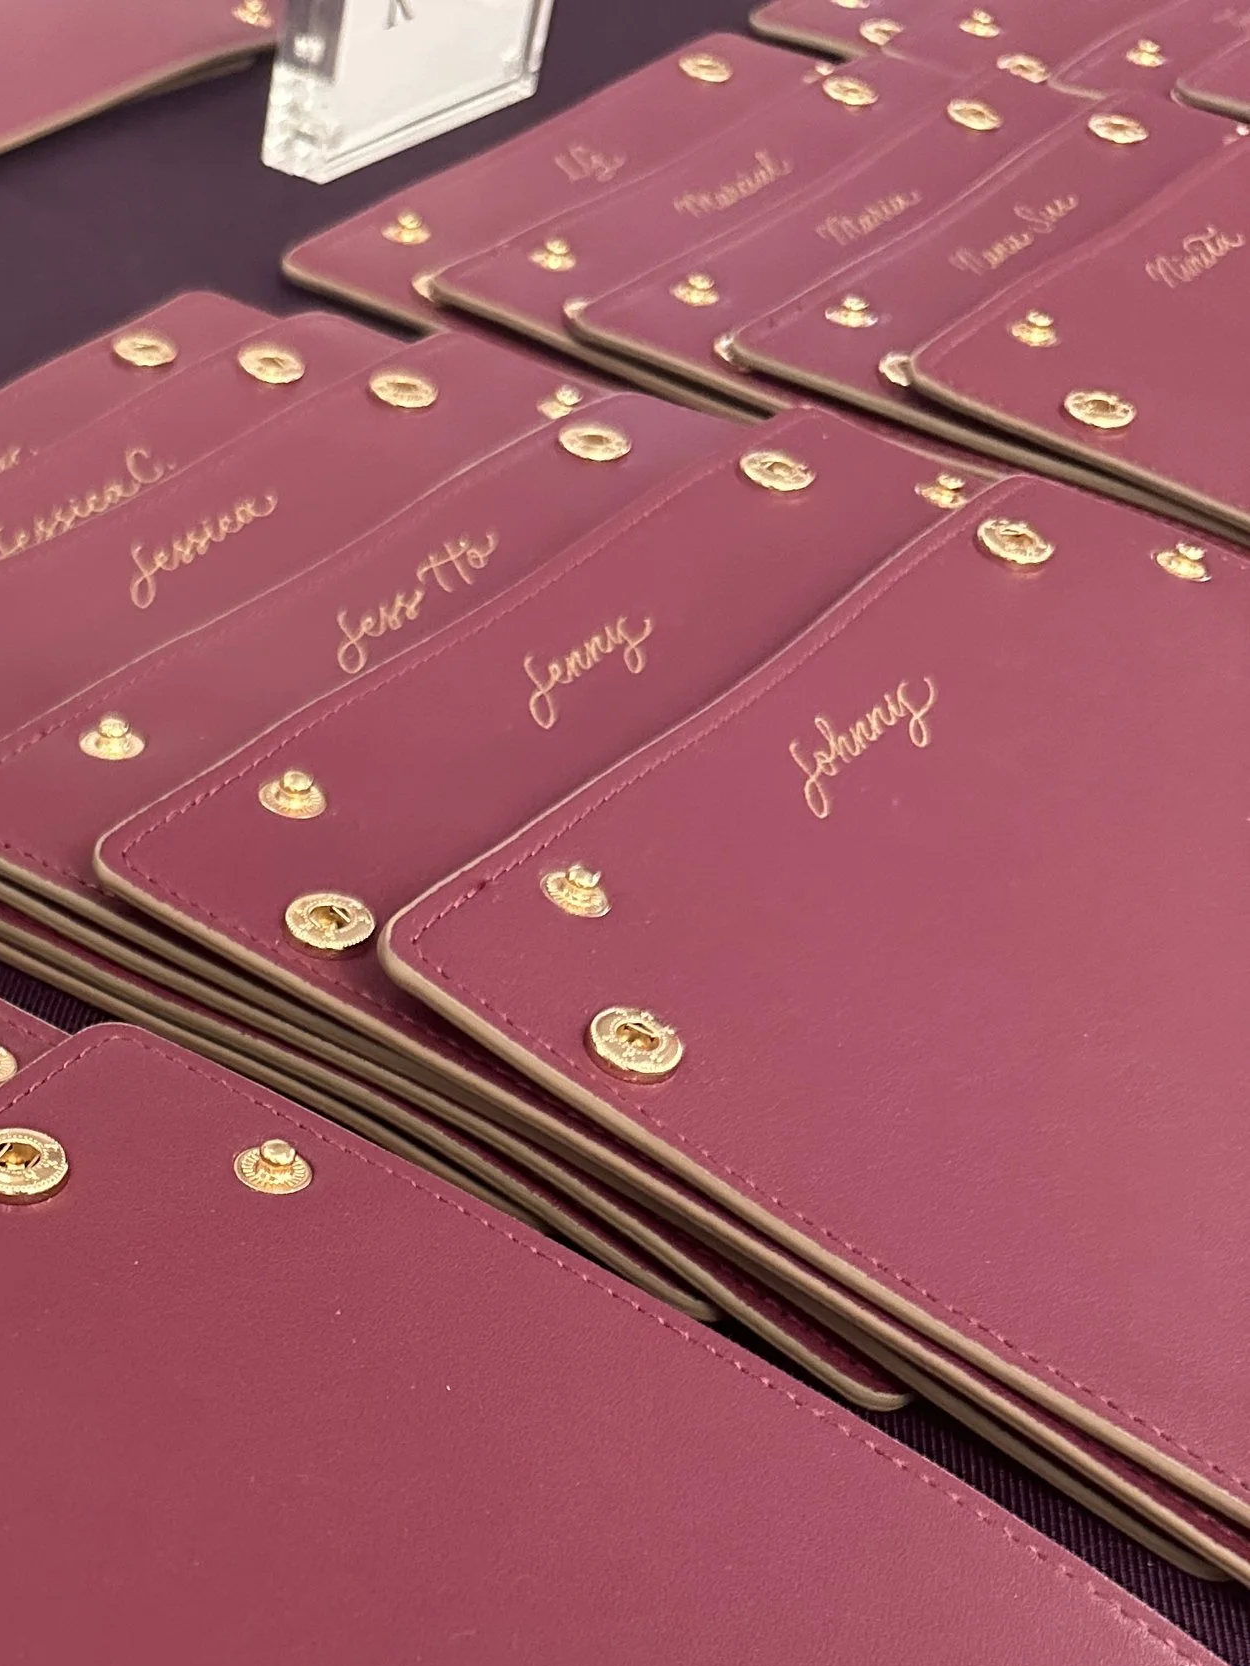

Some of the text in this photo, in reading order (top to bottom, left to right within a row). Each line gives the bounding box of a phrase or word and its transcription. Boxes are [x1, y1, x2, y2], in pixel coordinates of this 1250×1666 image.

[130, 492, 278, 609] Jessica
[336, 589, 425, 674] Jess
[523, 614, 652, 729] Jenny
[789, 676, 936, 819] Johnny
